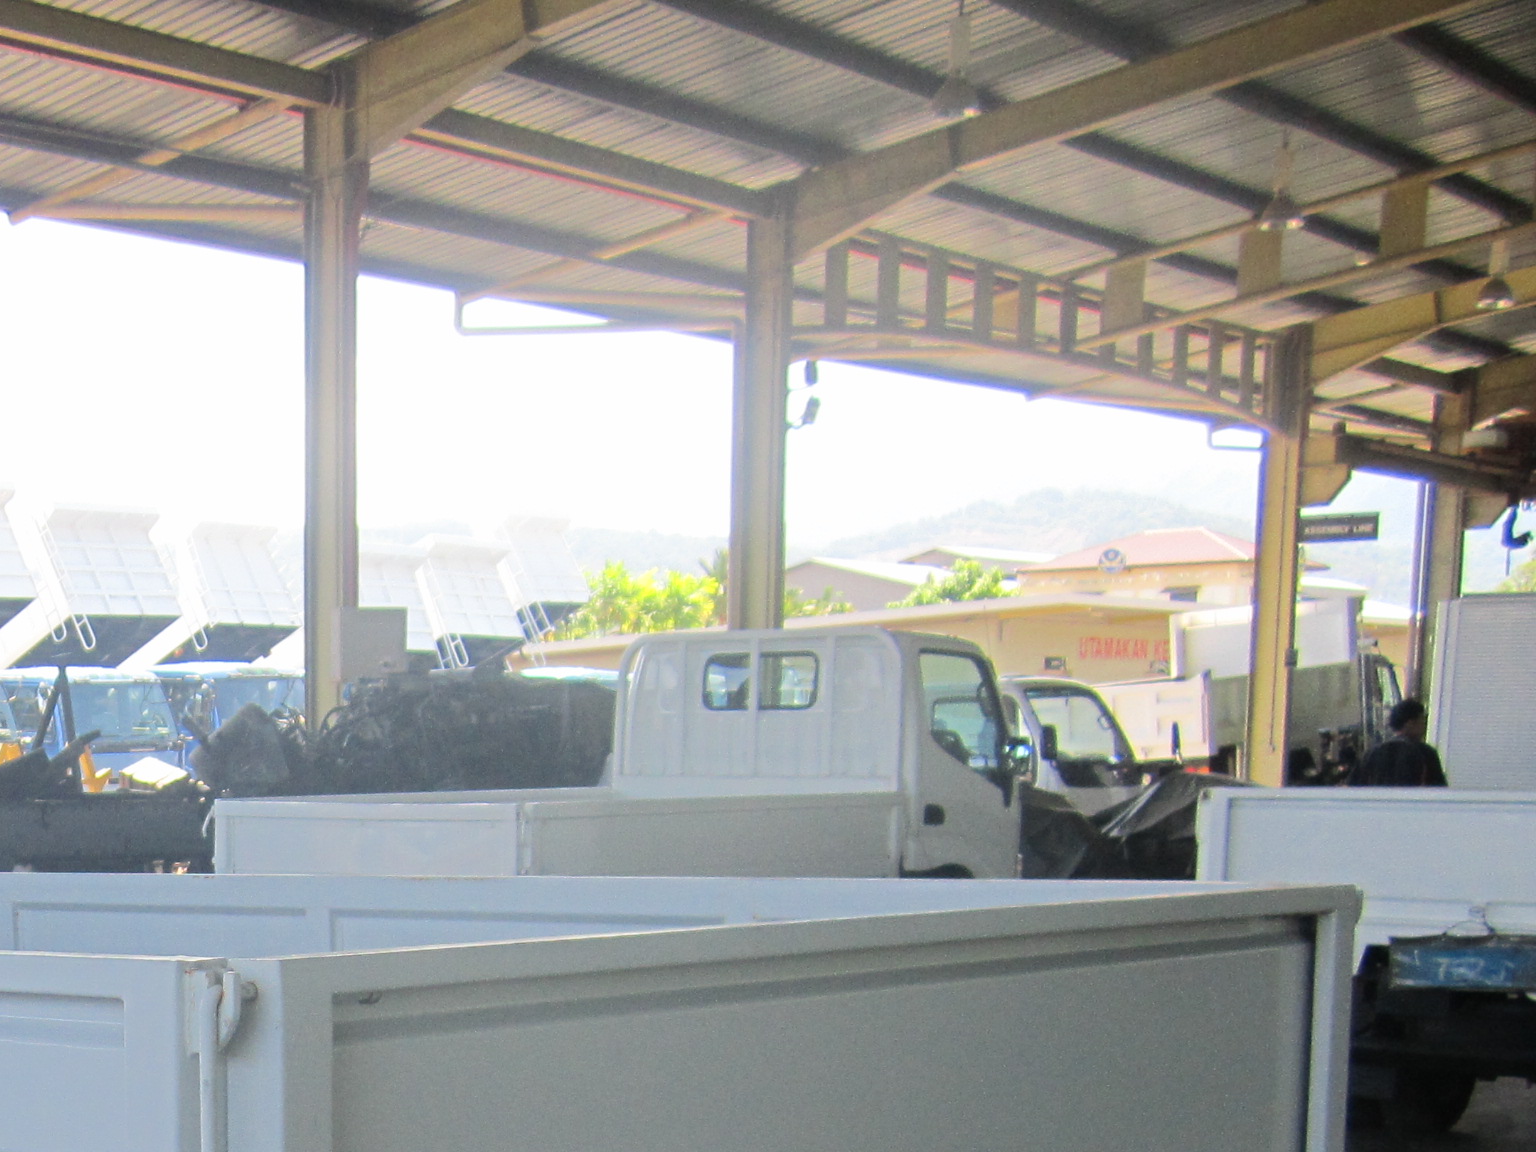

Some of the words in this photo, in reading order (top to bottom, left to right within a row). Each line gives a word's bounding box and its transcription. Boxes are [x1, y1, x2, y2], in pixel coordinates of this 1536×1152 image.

[1304, 525, 1350, 535] ASSEMBLY
[1353, 523, 1374, 533] LINE
[1079, 636, 1148, 659] UTAMAKAN
